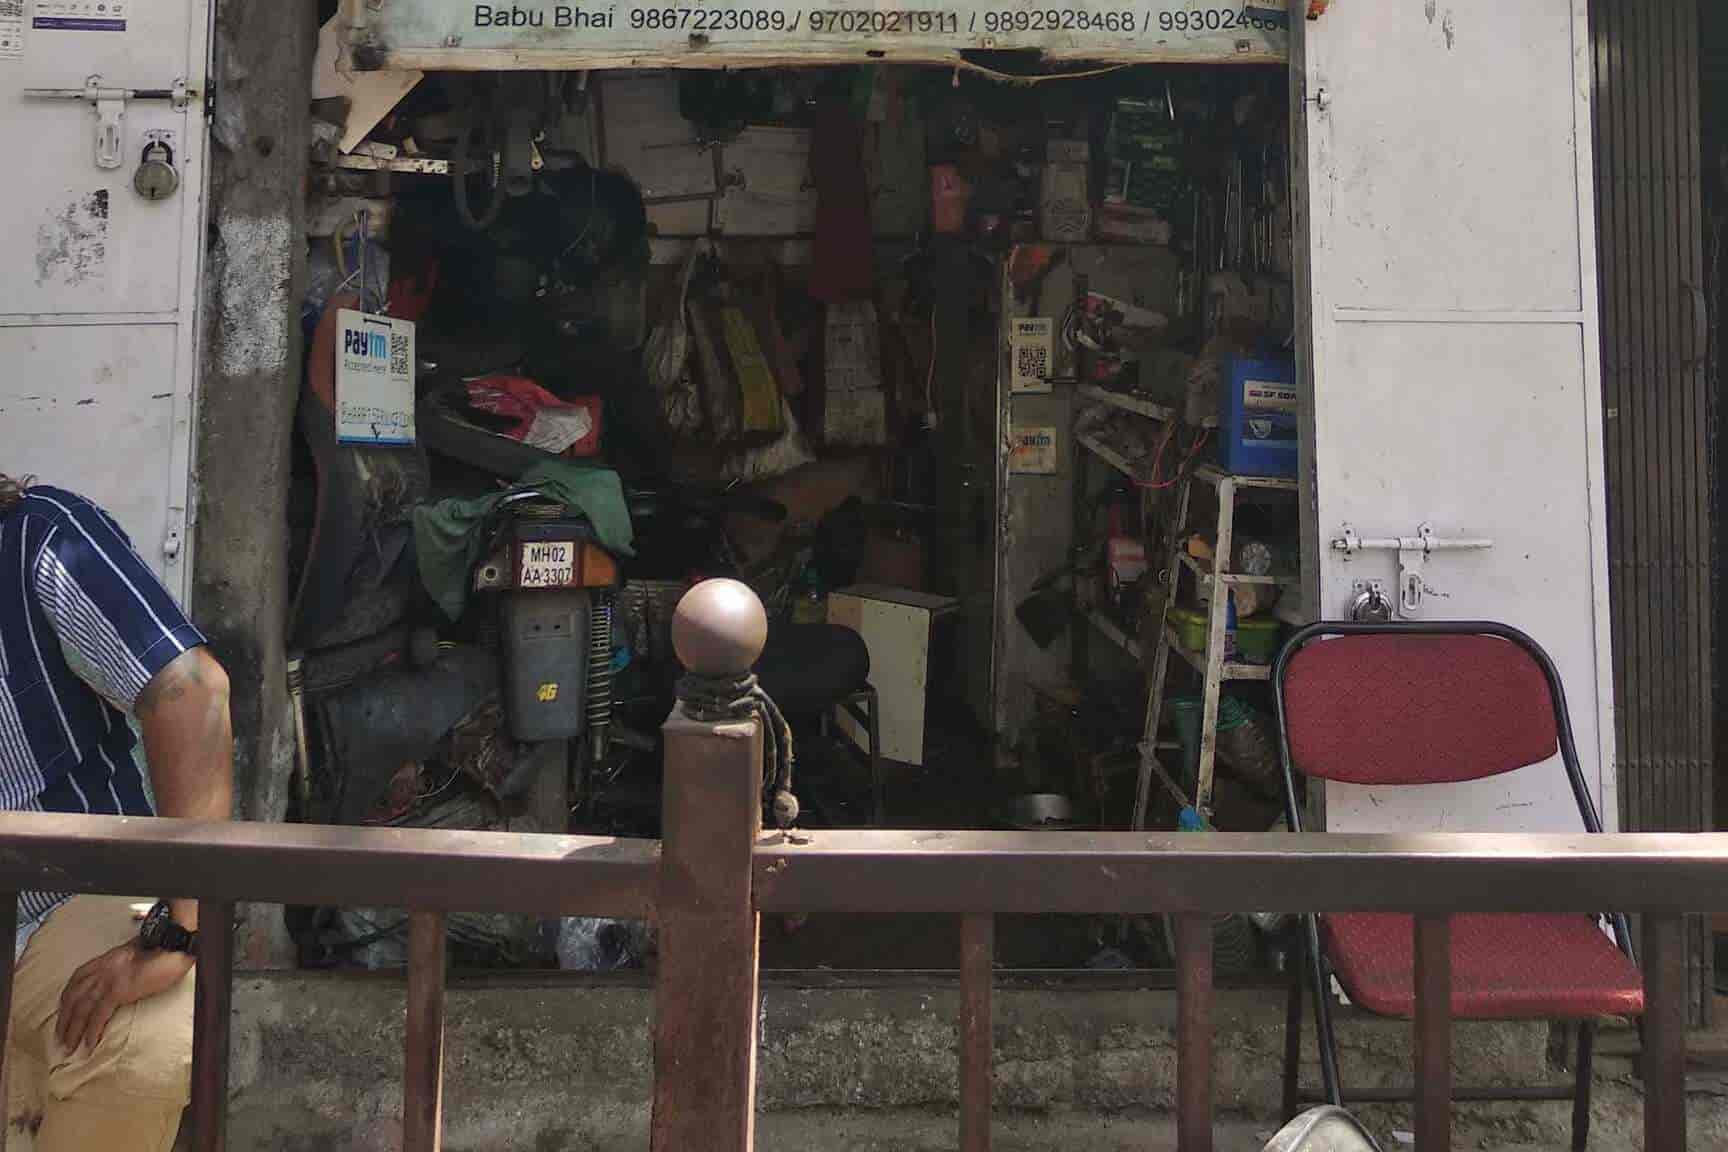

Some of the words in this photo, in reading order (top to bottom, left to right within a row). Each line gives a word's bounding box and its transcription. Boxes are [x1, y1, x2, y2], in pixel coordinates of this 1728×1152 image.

[473, 5, 543, 28] Babu
[554, 6, 615, 28] Bhai
[630, 8, 785, 30] 9867223089
[809, 10, 957, 32] 9702021911
[984, 11, 1134, 33] 9892928468
